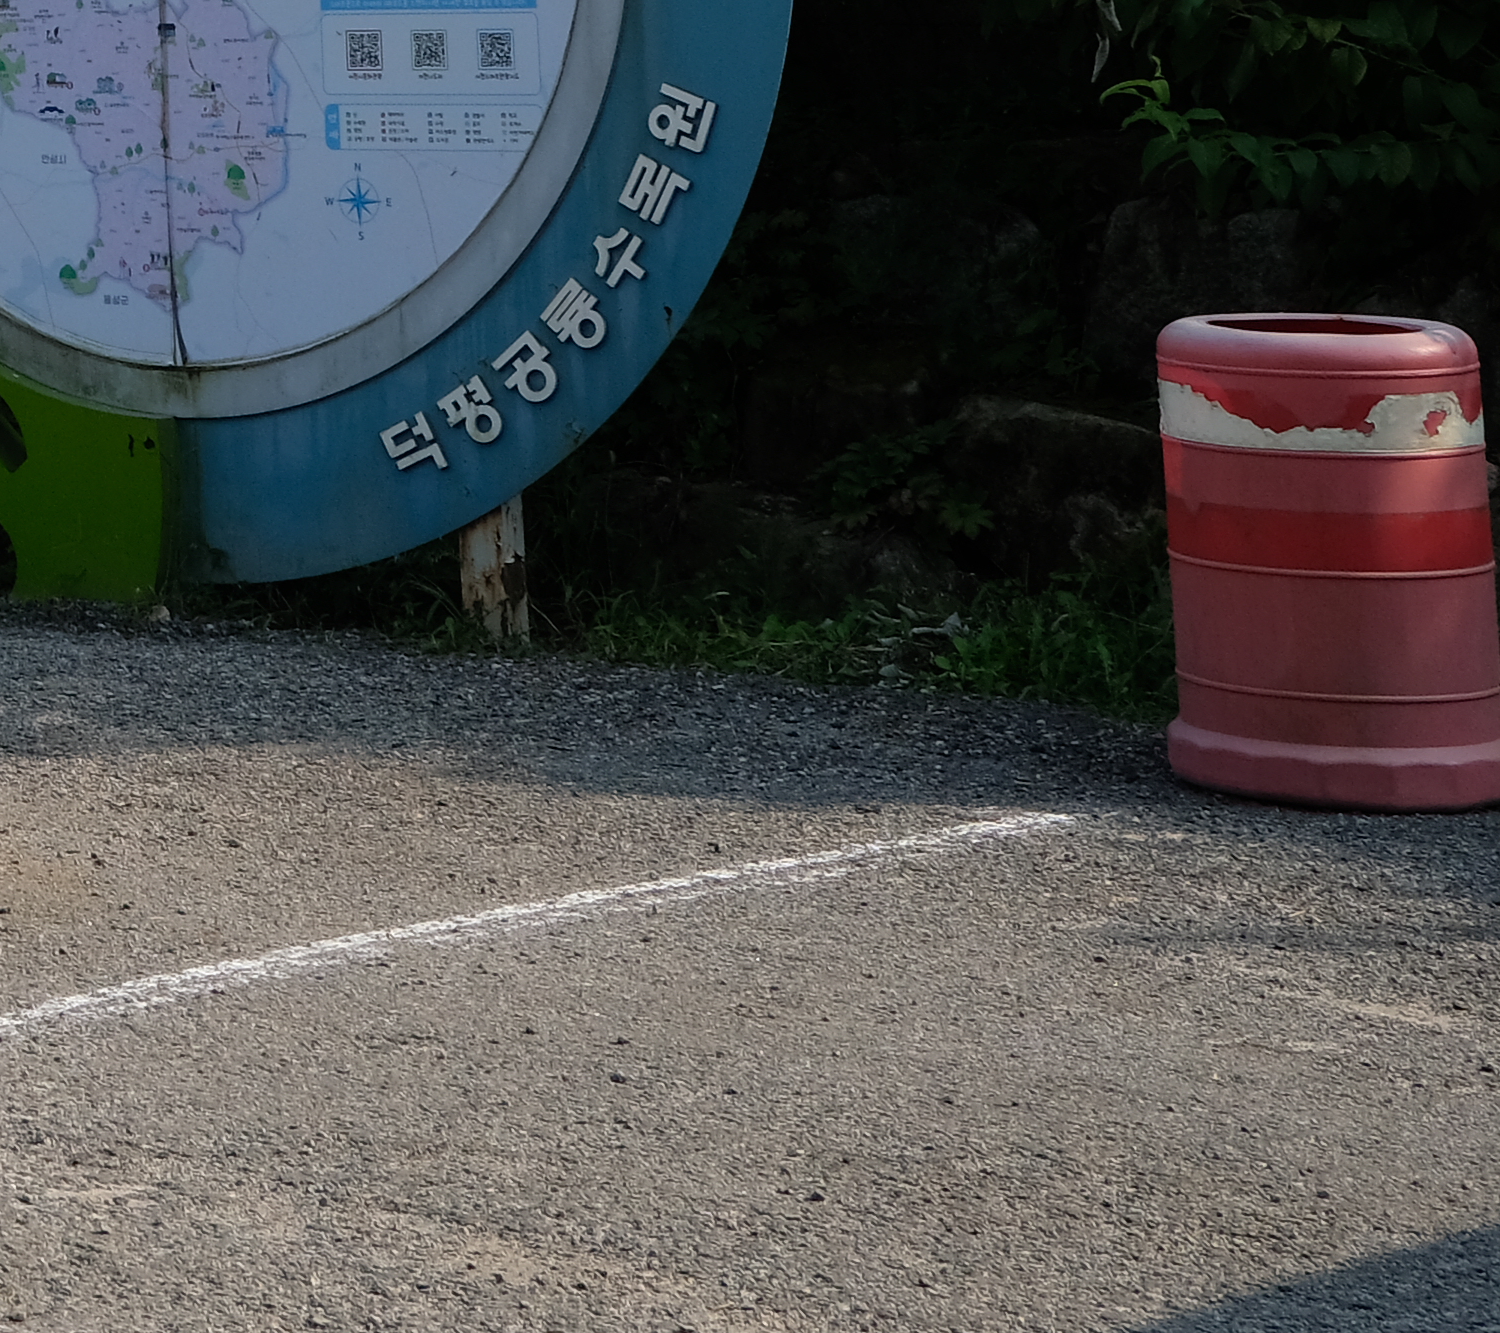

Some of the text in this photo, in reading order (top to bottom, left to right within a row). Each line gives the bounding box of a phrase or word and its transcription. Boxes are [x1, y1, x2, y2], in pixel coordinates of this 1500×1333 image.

[354, 162, 362, 172] N
[324, 197, 335, 206] W
[386, 197, 392, 207] E
[358, 231, 365, 241] S
[378, 82, 720, 471] 덕평공룡수목원
